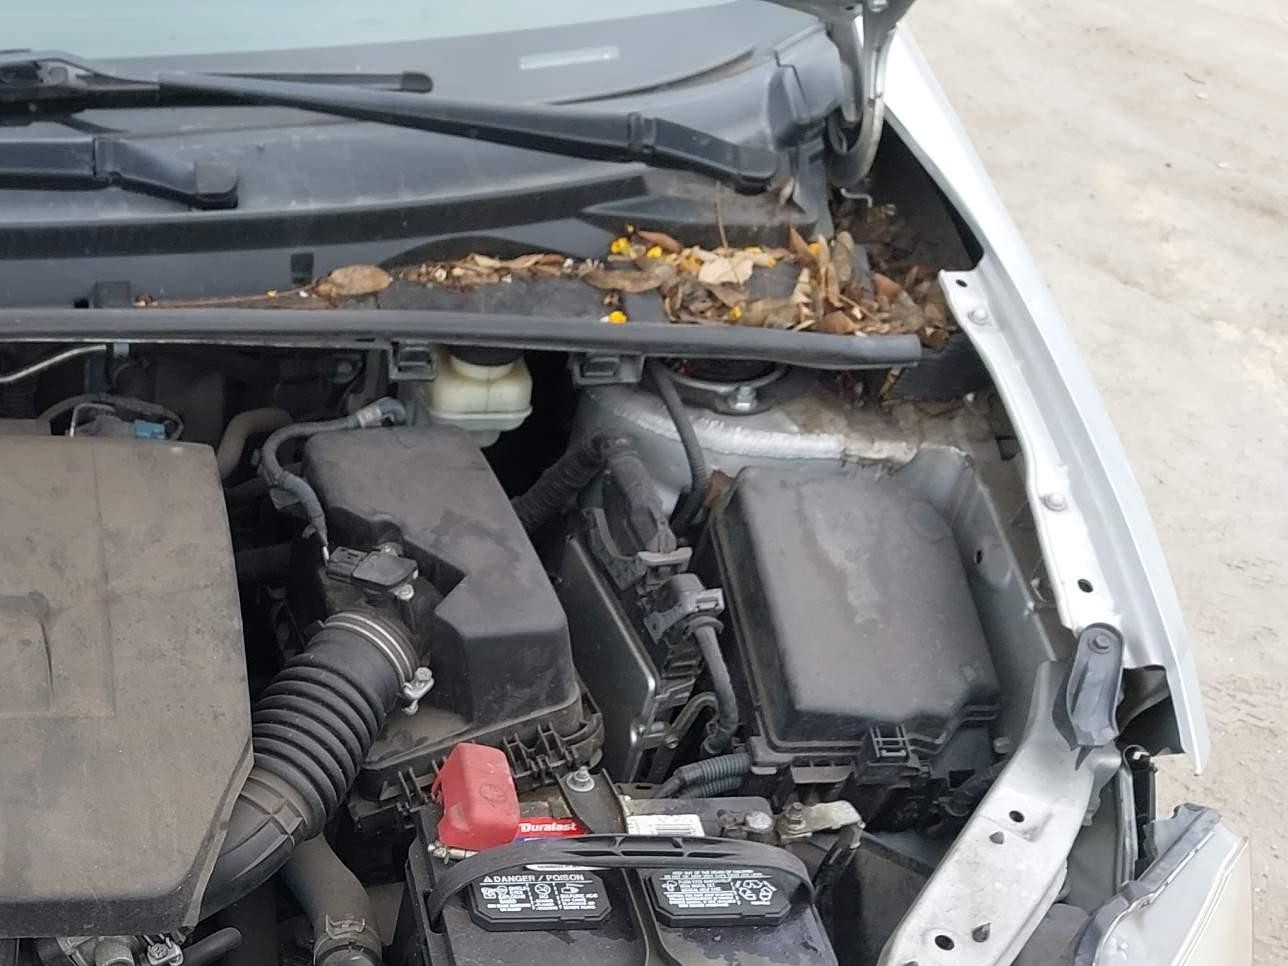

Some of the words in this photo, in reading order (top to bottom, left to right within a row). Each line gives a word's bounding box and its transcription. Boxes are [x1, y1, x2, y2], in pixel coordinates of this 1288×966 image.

[519, 822, 577, 833] Duralast
[492, 875, 536, 883] DANGER
[545, 873, 585, 881] POISON
